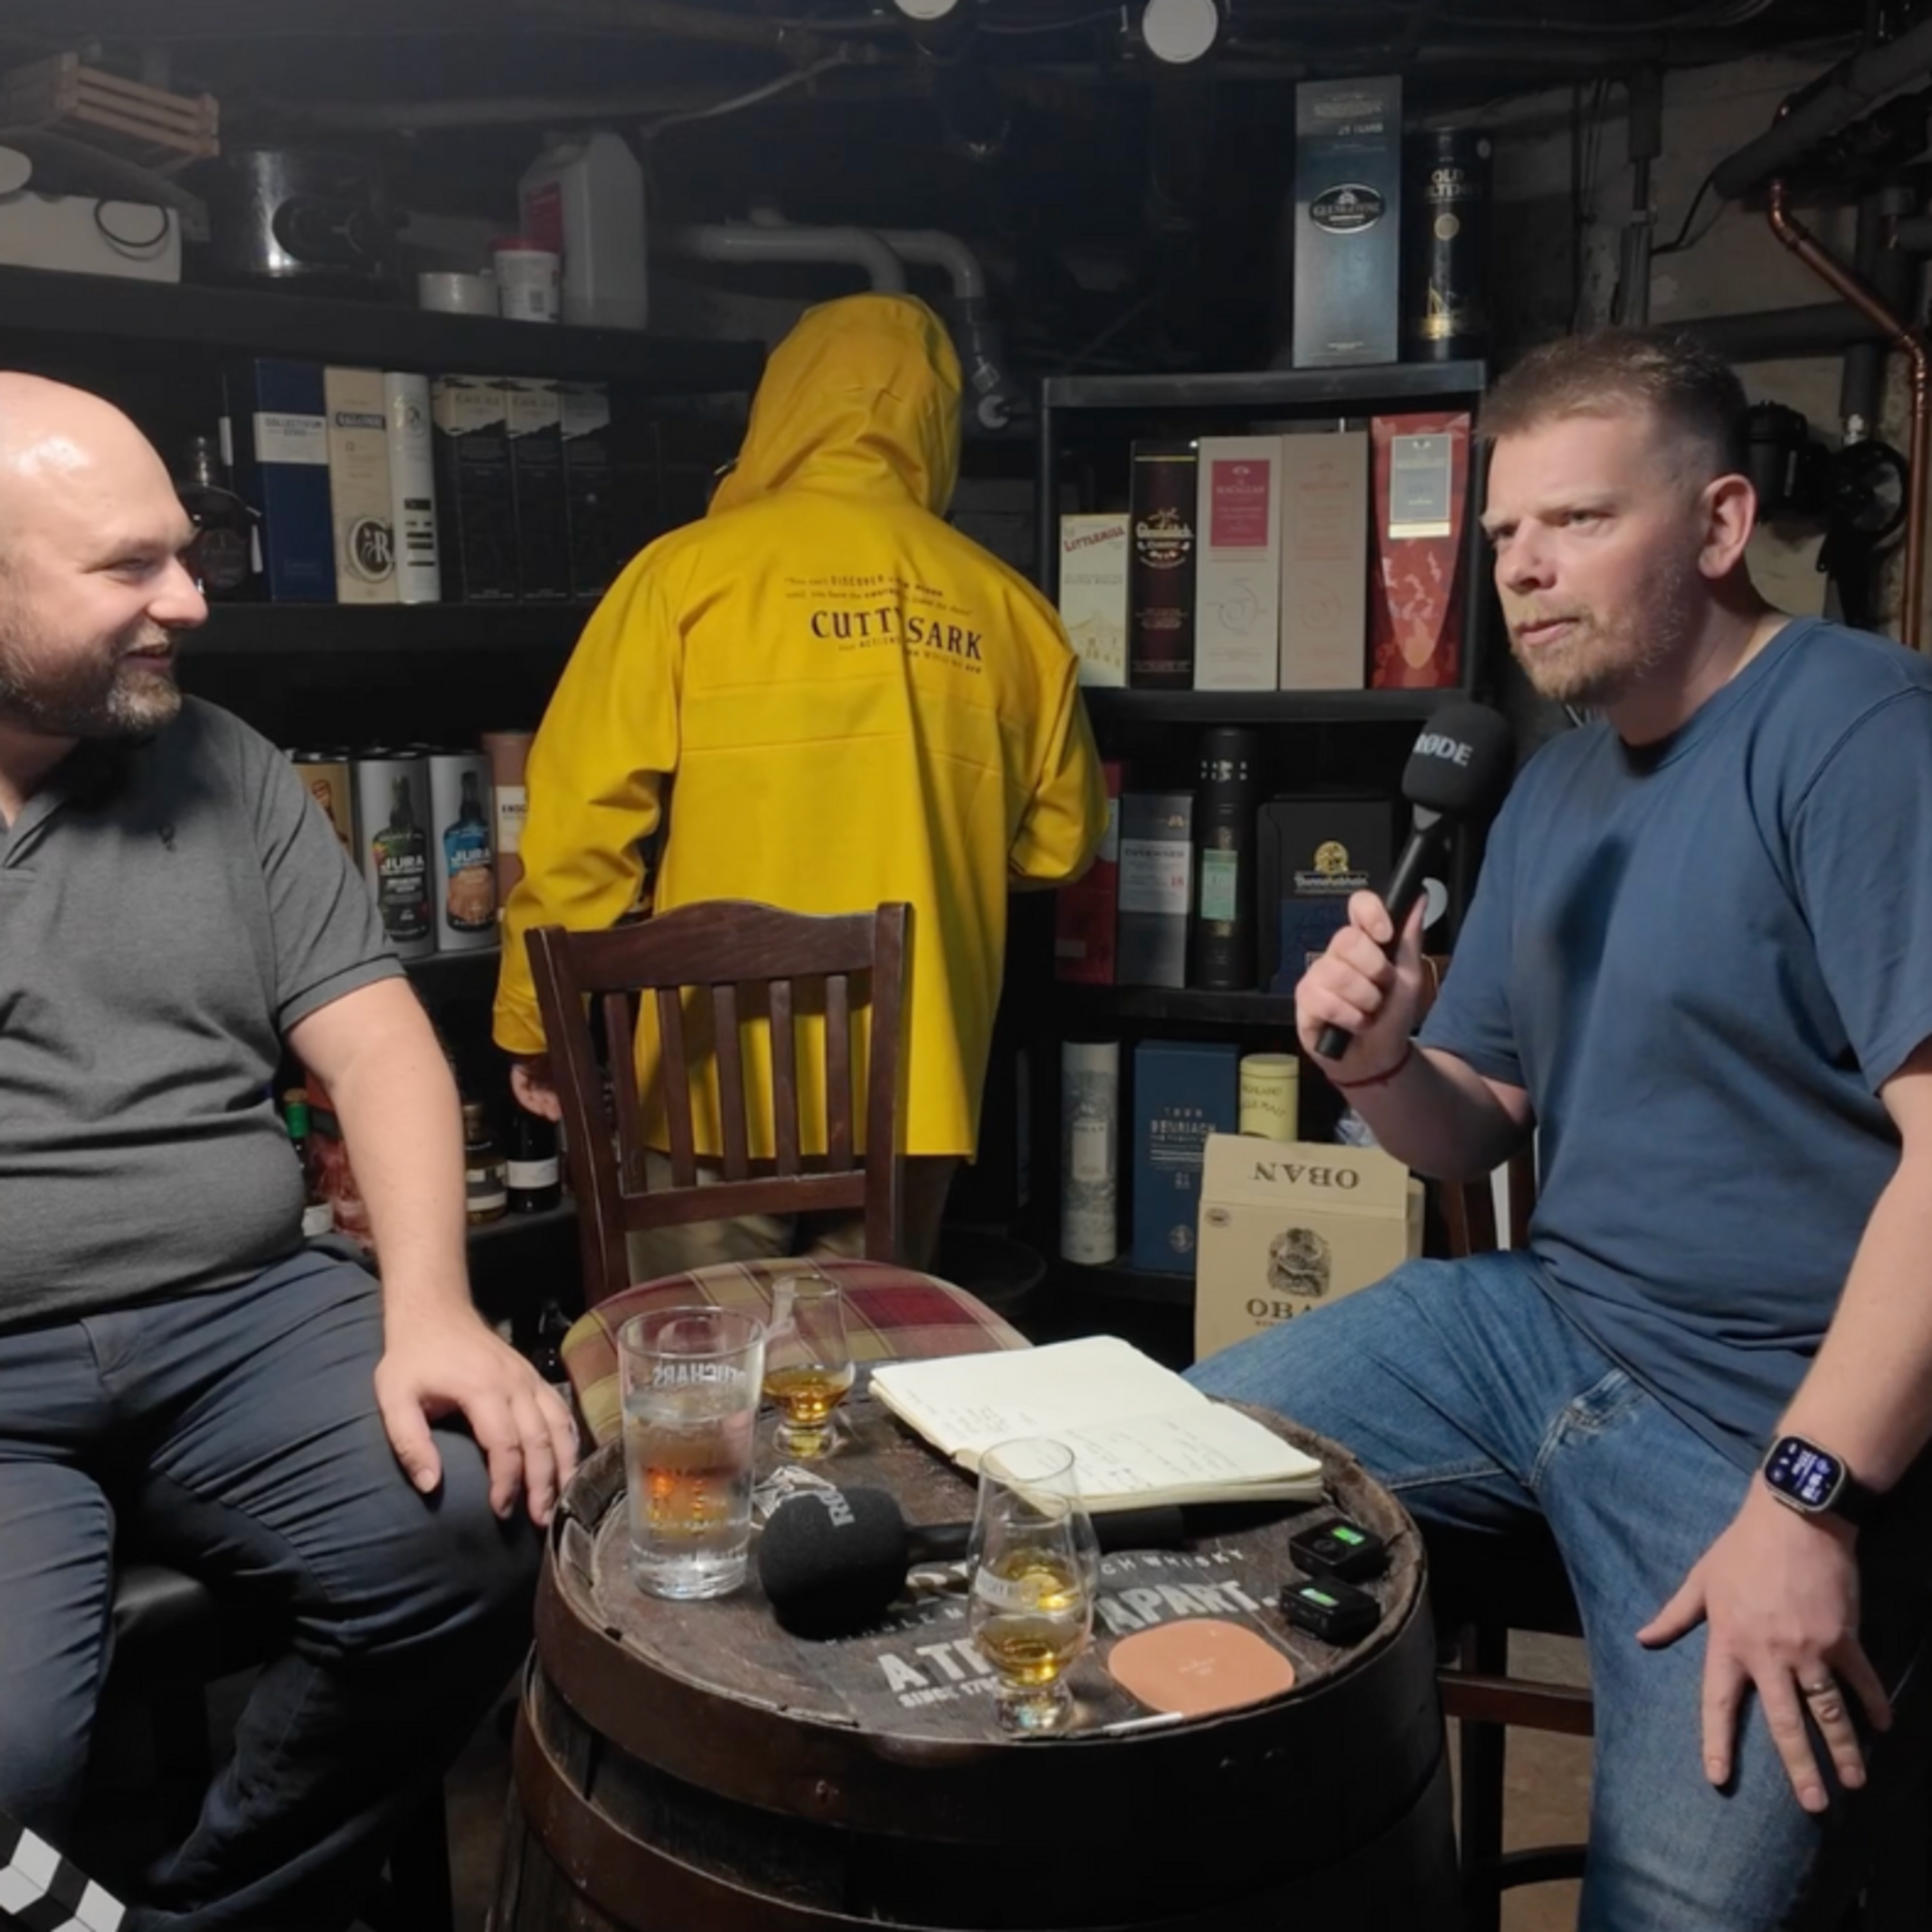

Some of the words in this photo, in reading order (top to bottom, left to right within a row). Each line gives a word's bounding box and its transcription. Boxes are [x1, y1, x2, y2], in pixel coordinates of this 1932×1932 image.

[907, 616, 982, 661] SARK
[381, 855, 425, 869] JURA
[451, 848, 491, 862] JURA
[1150, 1120, 1217, 1135] BENRIACH
[1252, 1161, 1360, 1190] OBAN
[1142, 1548, 1244, 1568] WHISKY
[878, 1653, 929, 1692] A
[898, 1686, 960, 1707] SINCE
